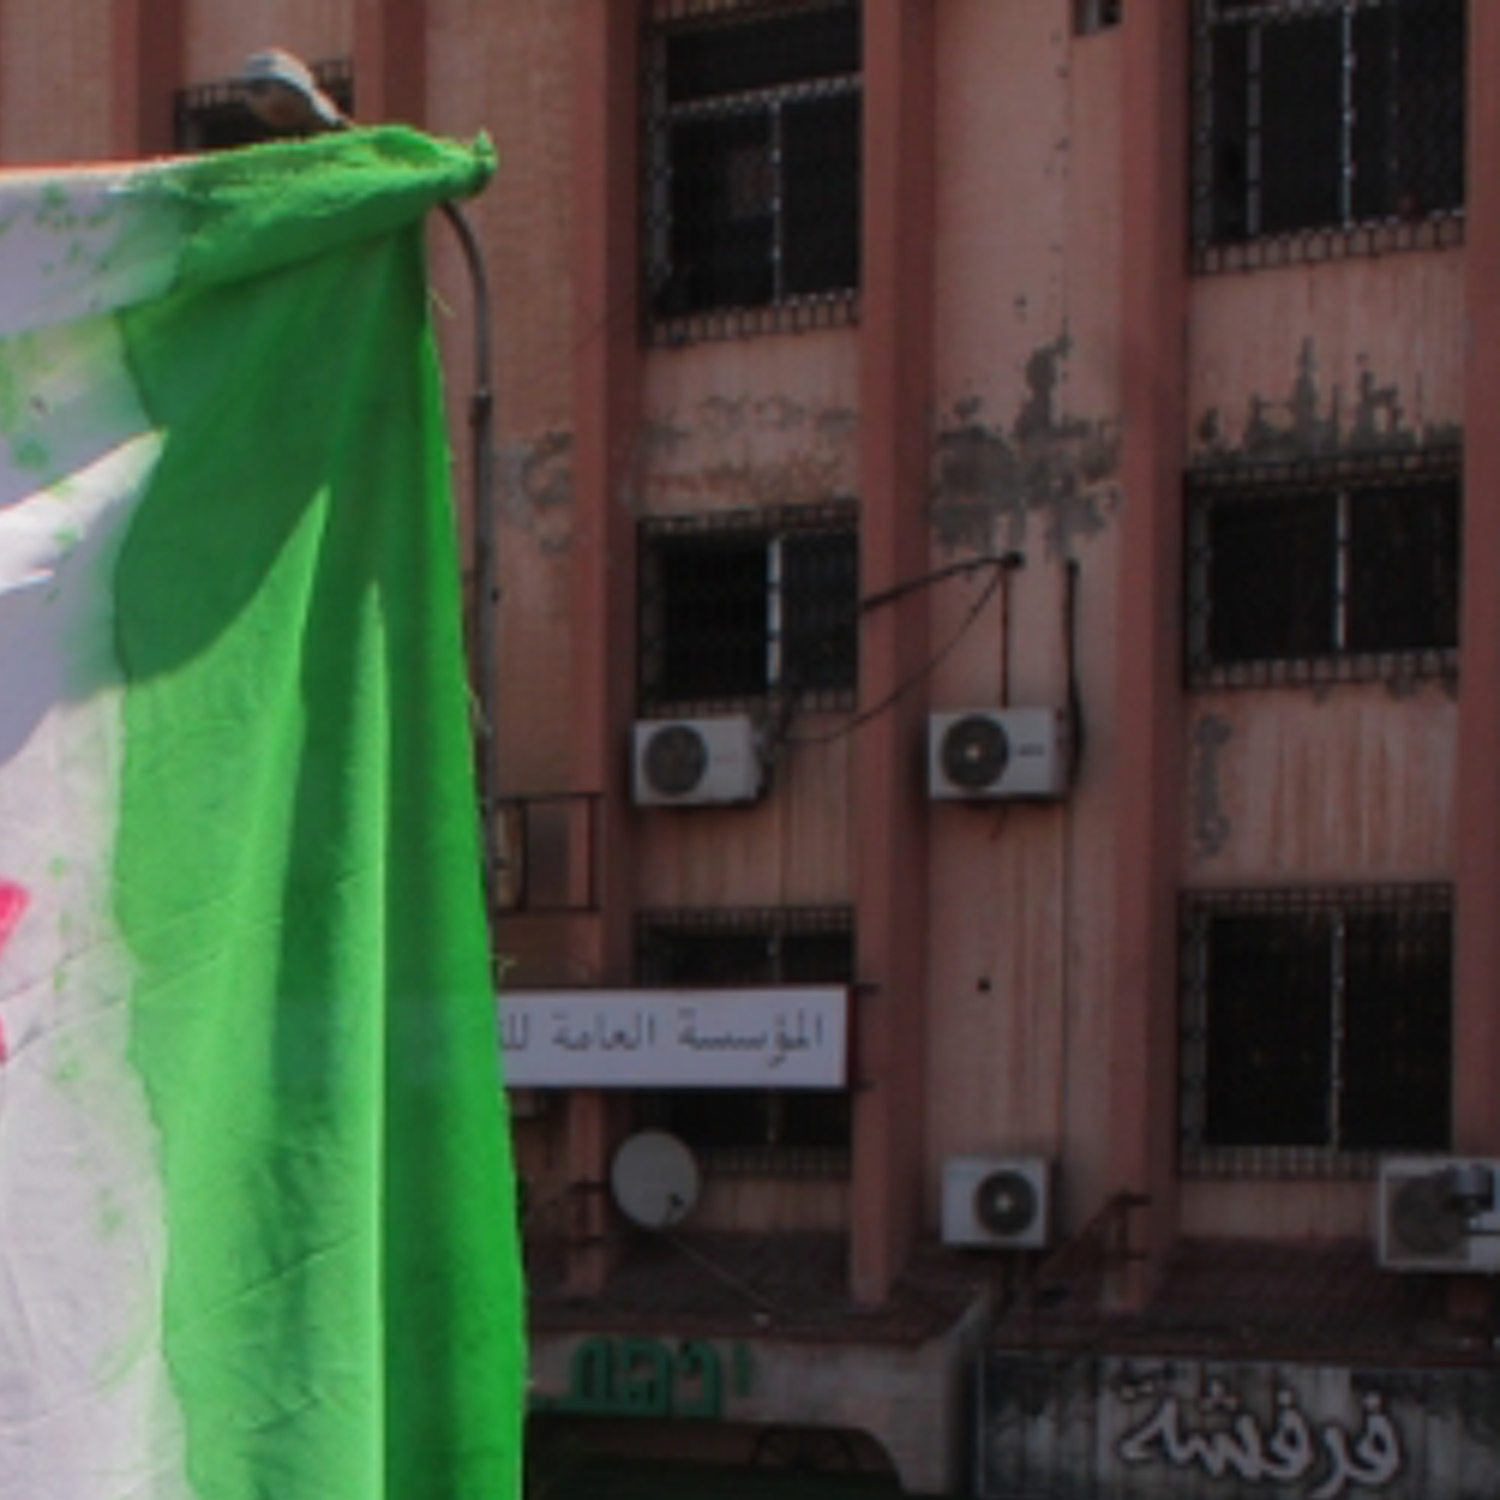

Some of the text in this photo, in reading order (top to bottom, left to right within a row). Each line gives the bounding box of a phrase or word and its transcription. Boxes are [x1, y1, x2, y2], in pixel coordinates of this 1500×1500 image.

[551, 1007, 656, 1052] العامة
[677, 1006, 824, 1068] المؤسسة
[1118, 1379, 1401, 1500] فرفشة
